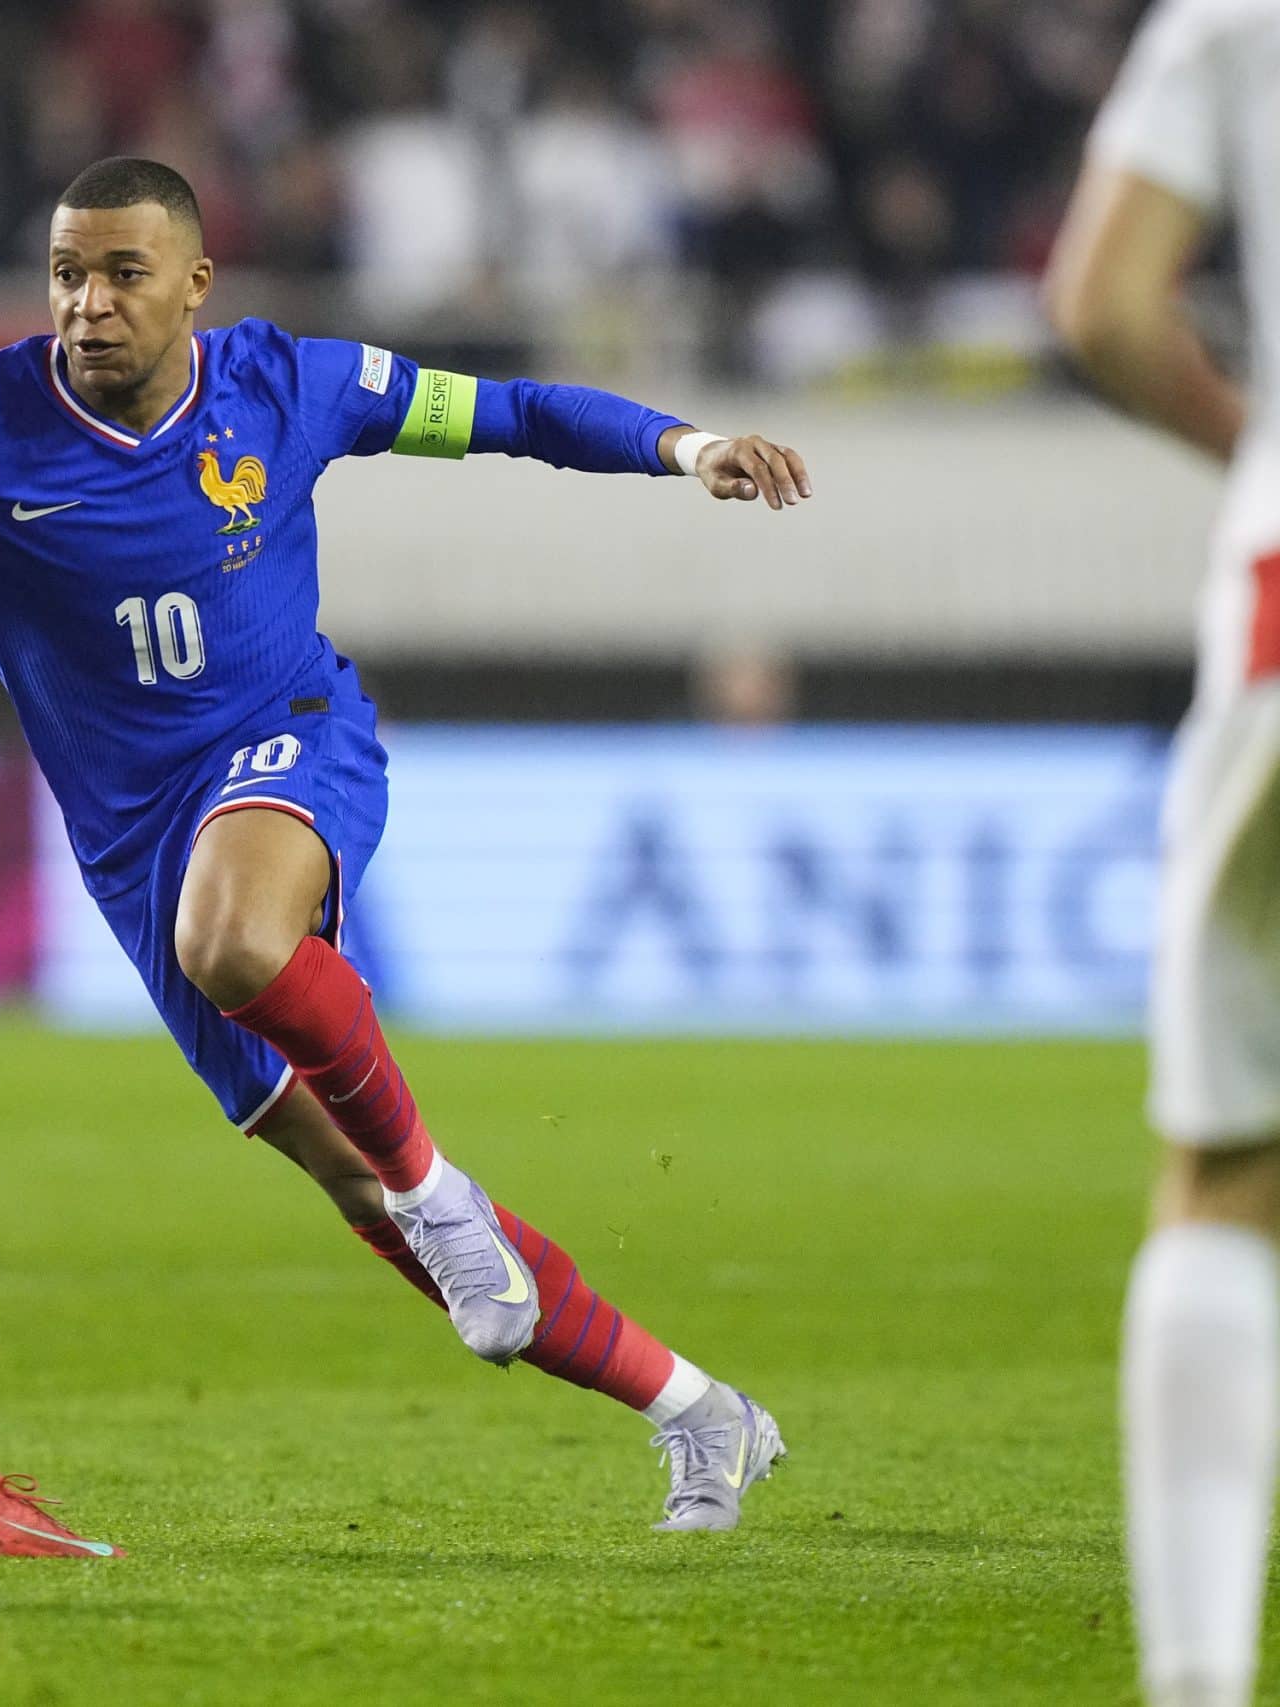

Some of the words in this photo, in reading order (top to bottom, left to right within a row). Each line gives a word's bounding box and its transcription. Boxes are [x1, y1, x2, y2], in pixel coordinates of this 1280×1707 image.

[429, 373, 448, 424] RESPECT
[115, 592, 205, 685] 10
[228, 733, 301, 780] 10
